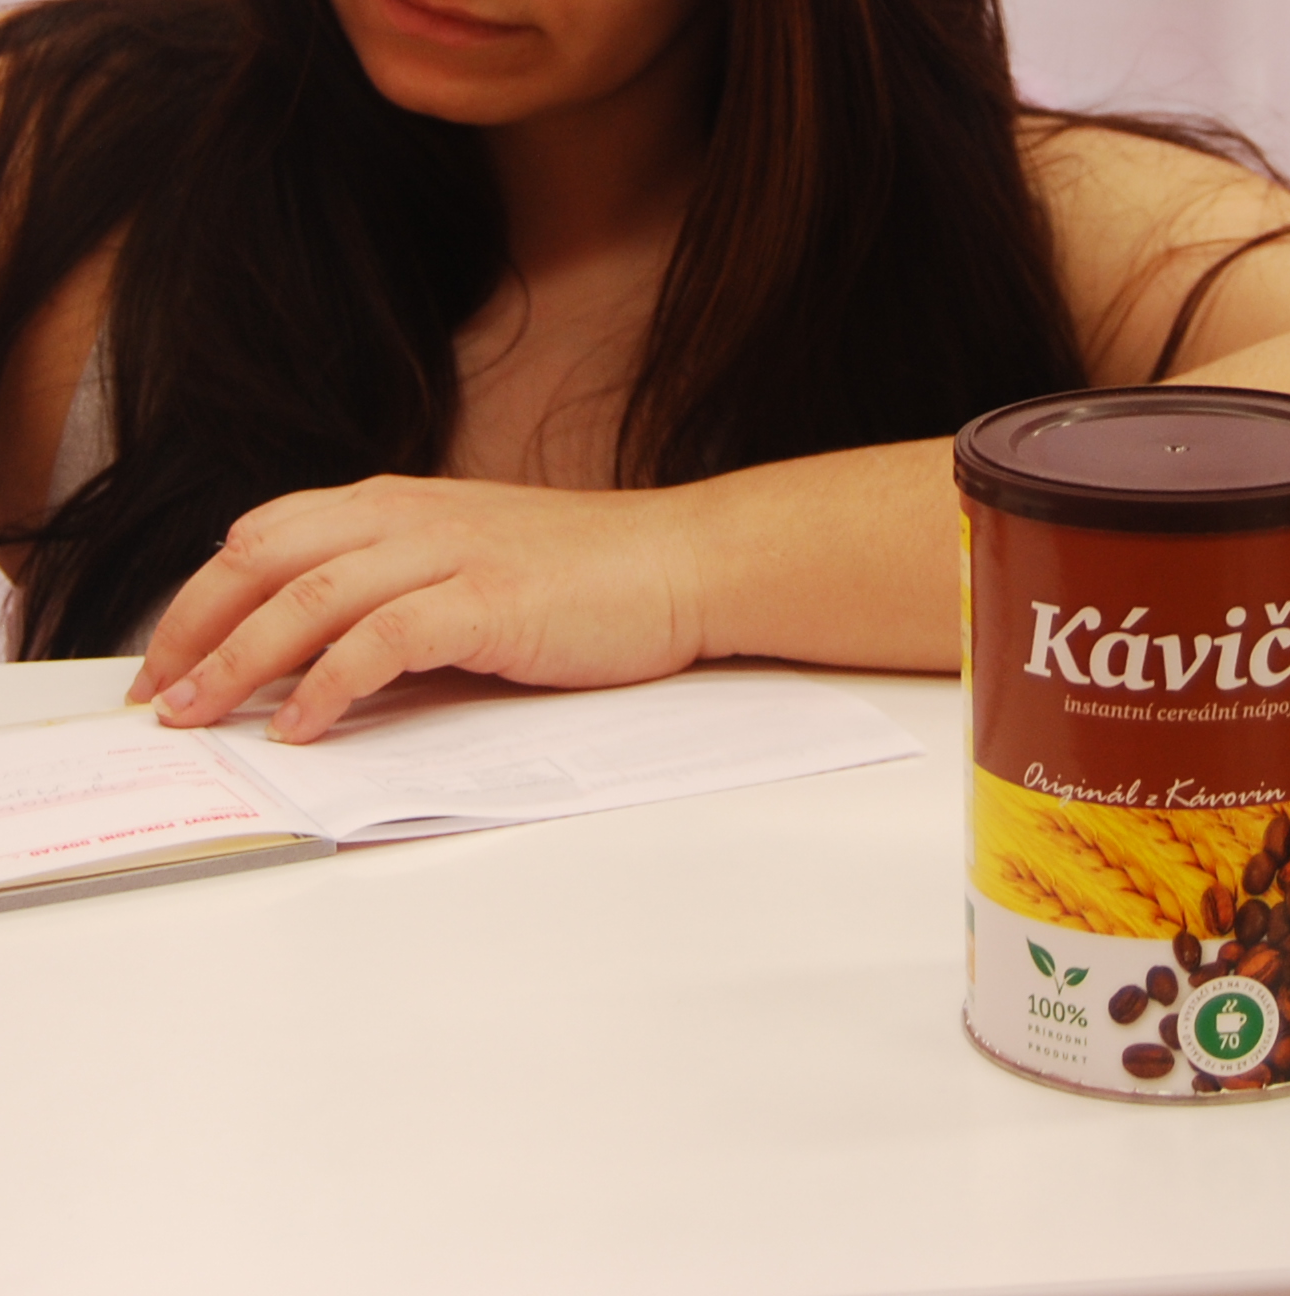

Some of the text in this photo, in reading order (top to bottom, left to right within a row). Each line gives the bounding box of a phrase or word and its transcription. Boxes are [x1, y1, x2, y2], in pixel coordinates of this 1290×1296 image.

[1064, 693, 1153, 721] instantní
[1156, 699, 1239, 722] cereální
[1023, 761, 1286, 809] Originál z Kávovin
[1027, 992, 1088, 1028] 100%
[1027, 1041, 1088, 1065] PRODUKT
[1218, 1033, 1240, 1051] 70
